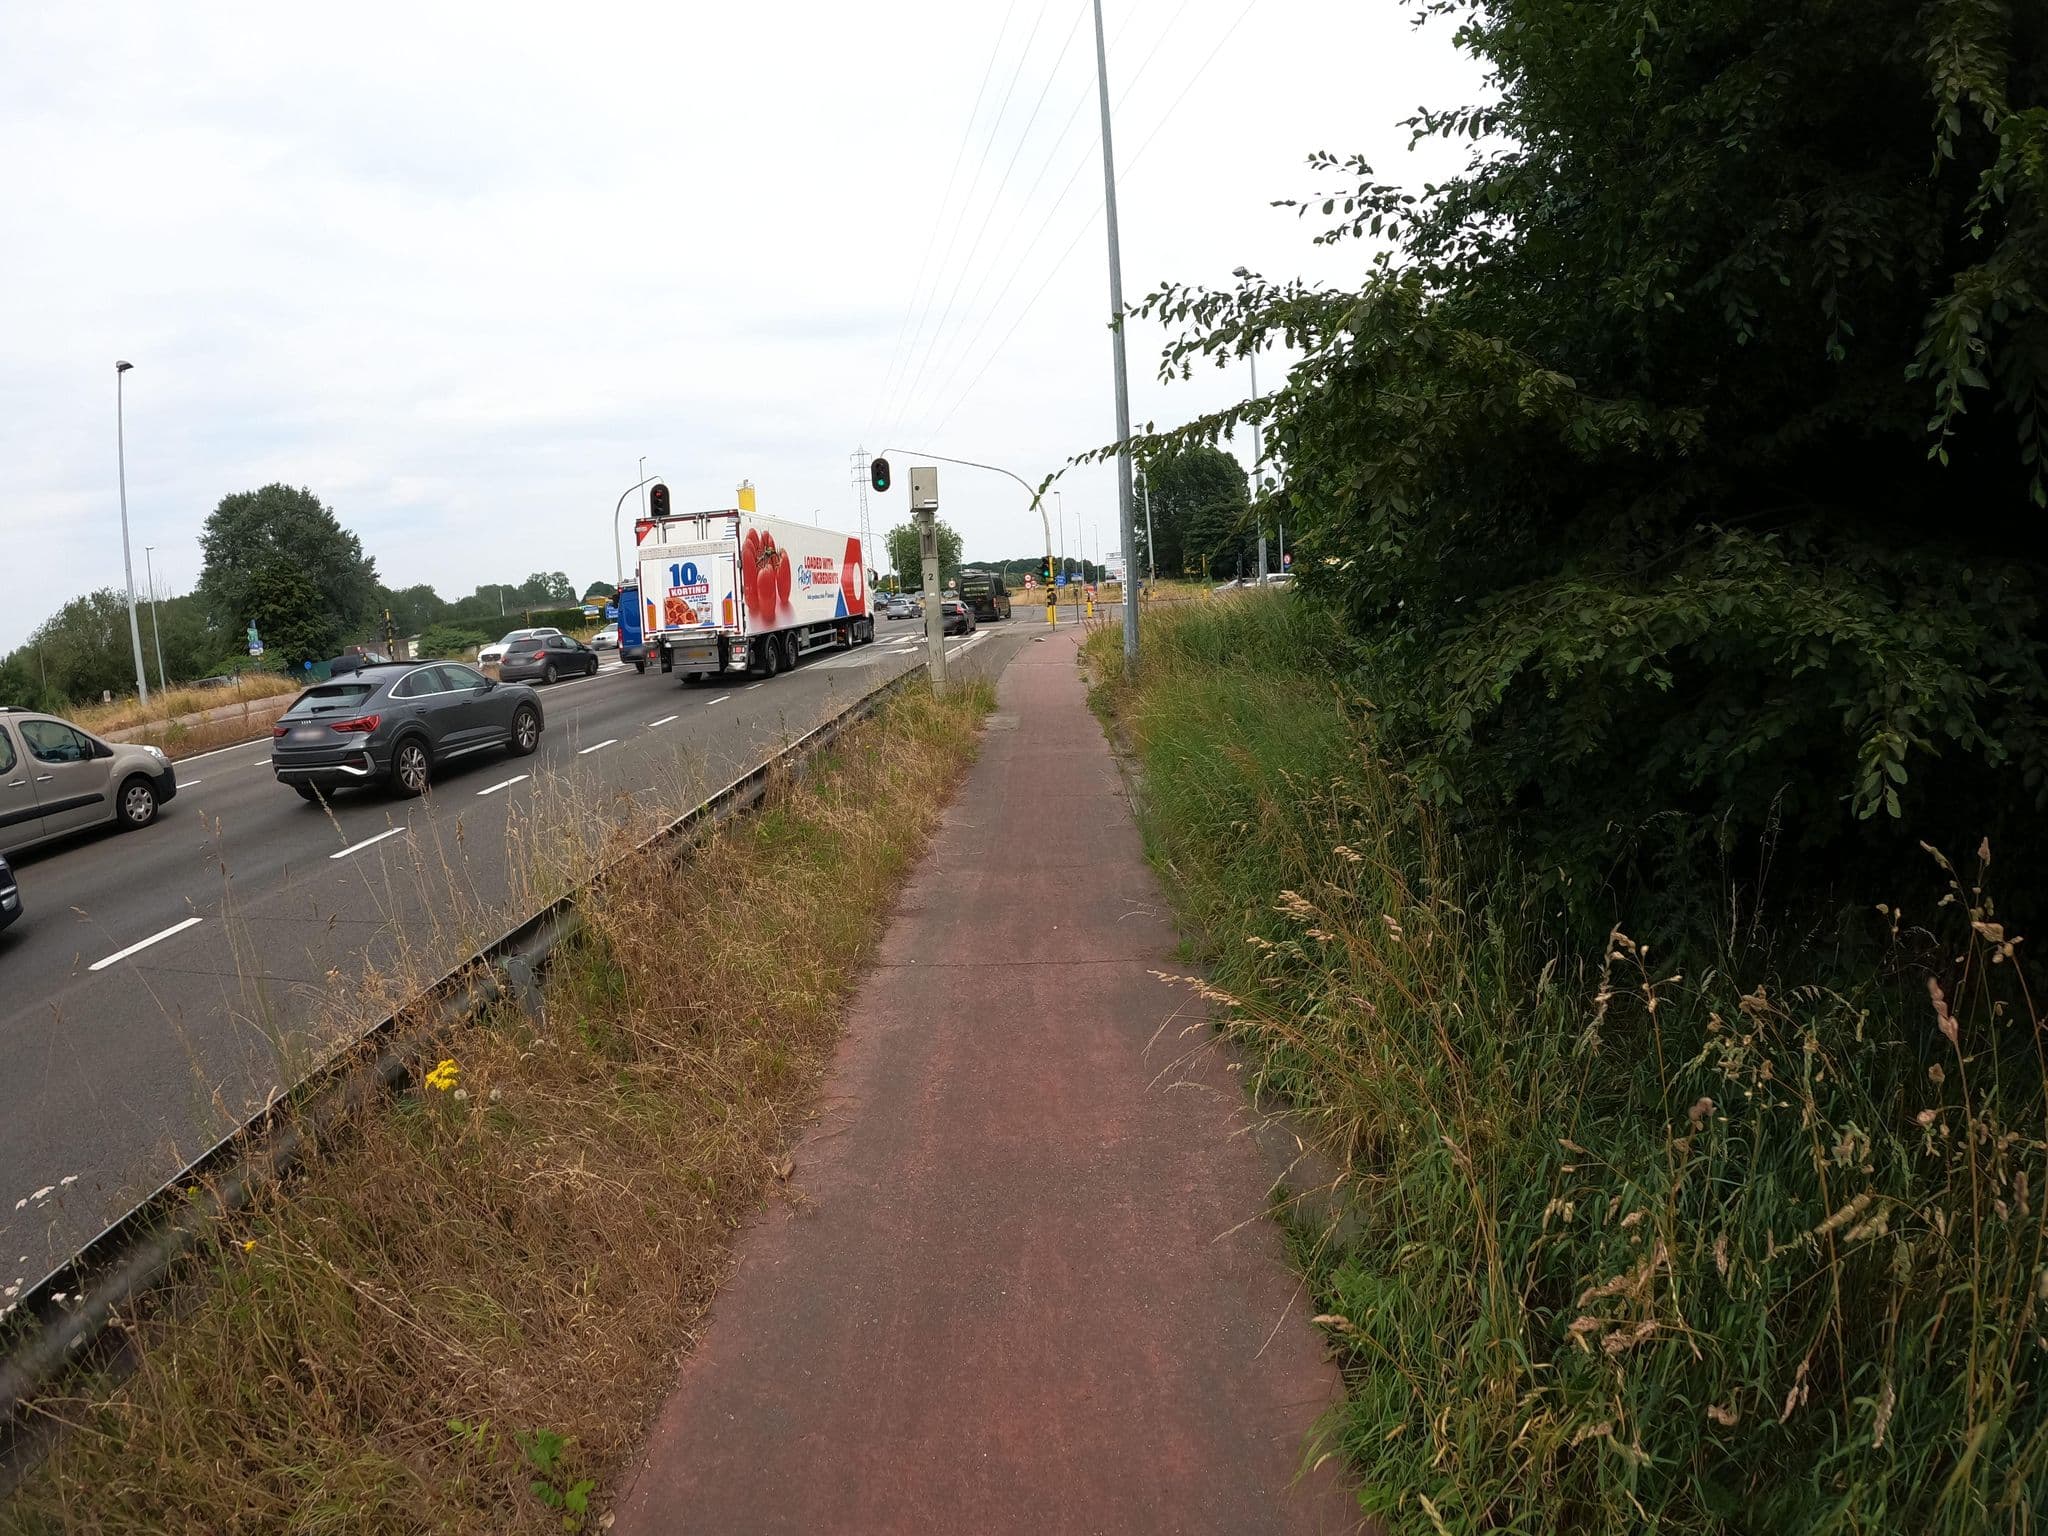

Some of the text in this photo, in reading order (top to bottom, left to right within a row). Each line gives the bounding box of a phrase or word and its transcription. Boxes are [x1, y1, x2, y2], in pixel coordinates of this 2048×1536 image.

[804, 555, 822, 570] LOADED
[669, 562, 708, 587] 10%
[812, 571, 839, 585] INGREDIENTS
[928, 573, 934, 581] 2
[670, 585, 708, 597] KORTING
